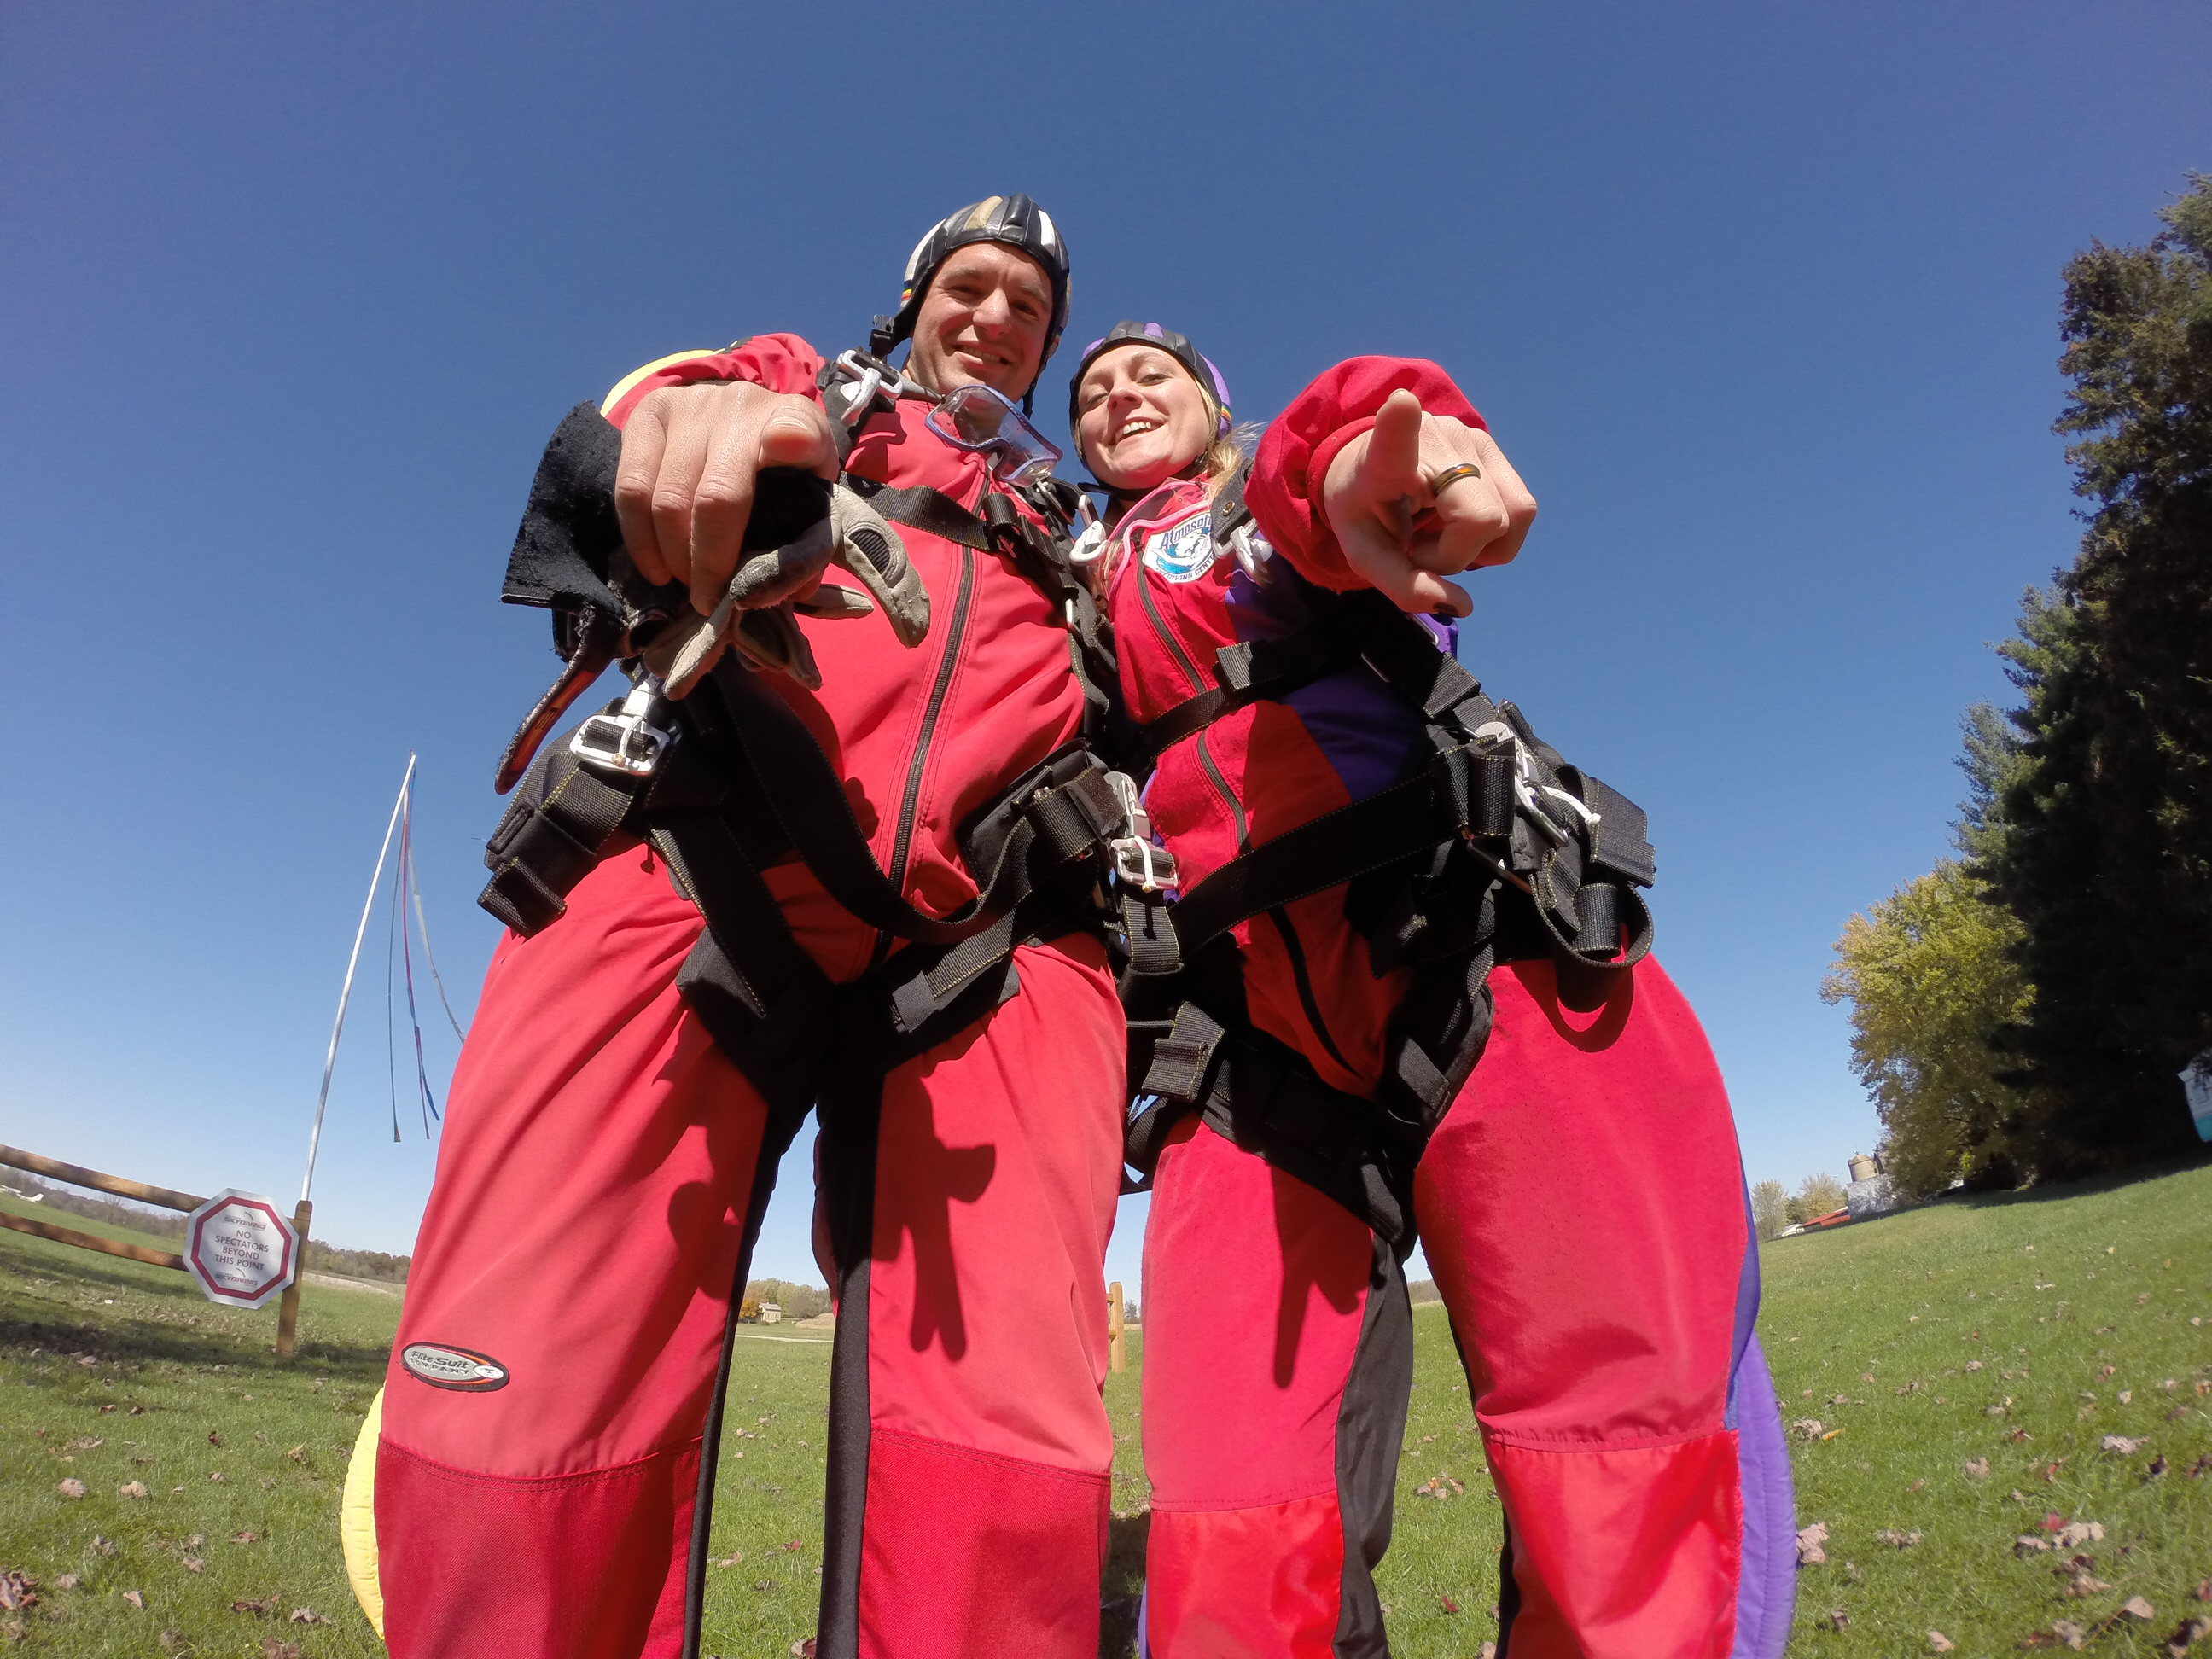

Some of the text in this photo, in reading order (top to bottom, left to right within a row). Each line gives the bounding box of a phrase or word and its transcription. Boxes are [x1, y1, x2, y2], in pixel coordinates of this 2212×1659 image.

[1159, 515, 1211, 549] Atmosph
[1195, 553, 1215, 576] CENTE
[236, 1230, 251, 1239] NO
[215, 1235, 269, 1253] SPECTATORS
[223, 1246, 259, 1260] BEYOND
[214, 1254, 265, 1271] THIS POINT
[410, 1358, 469, 1374] COMPANY
